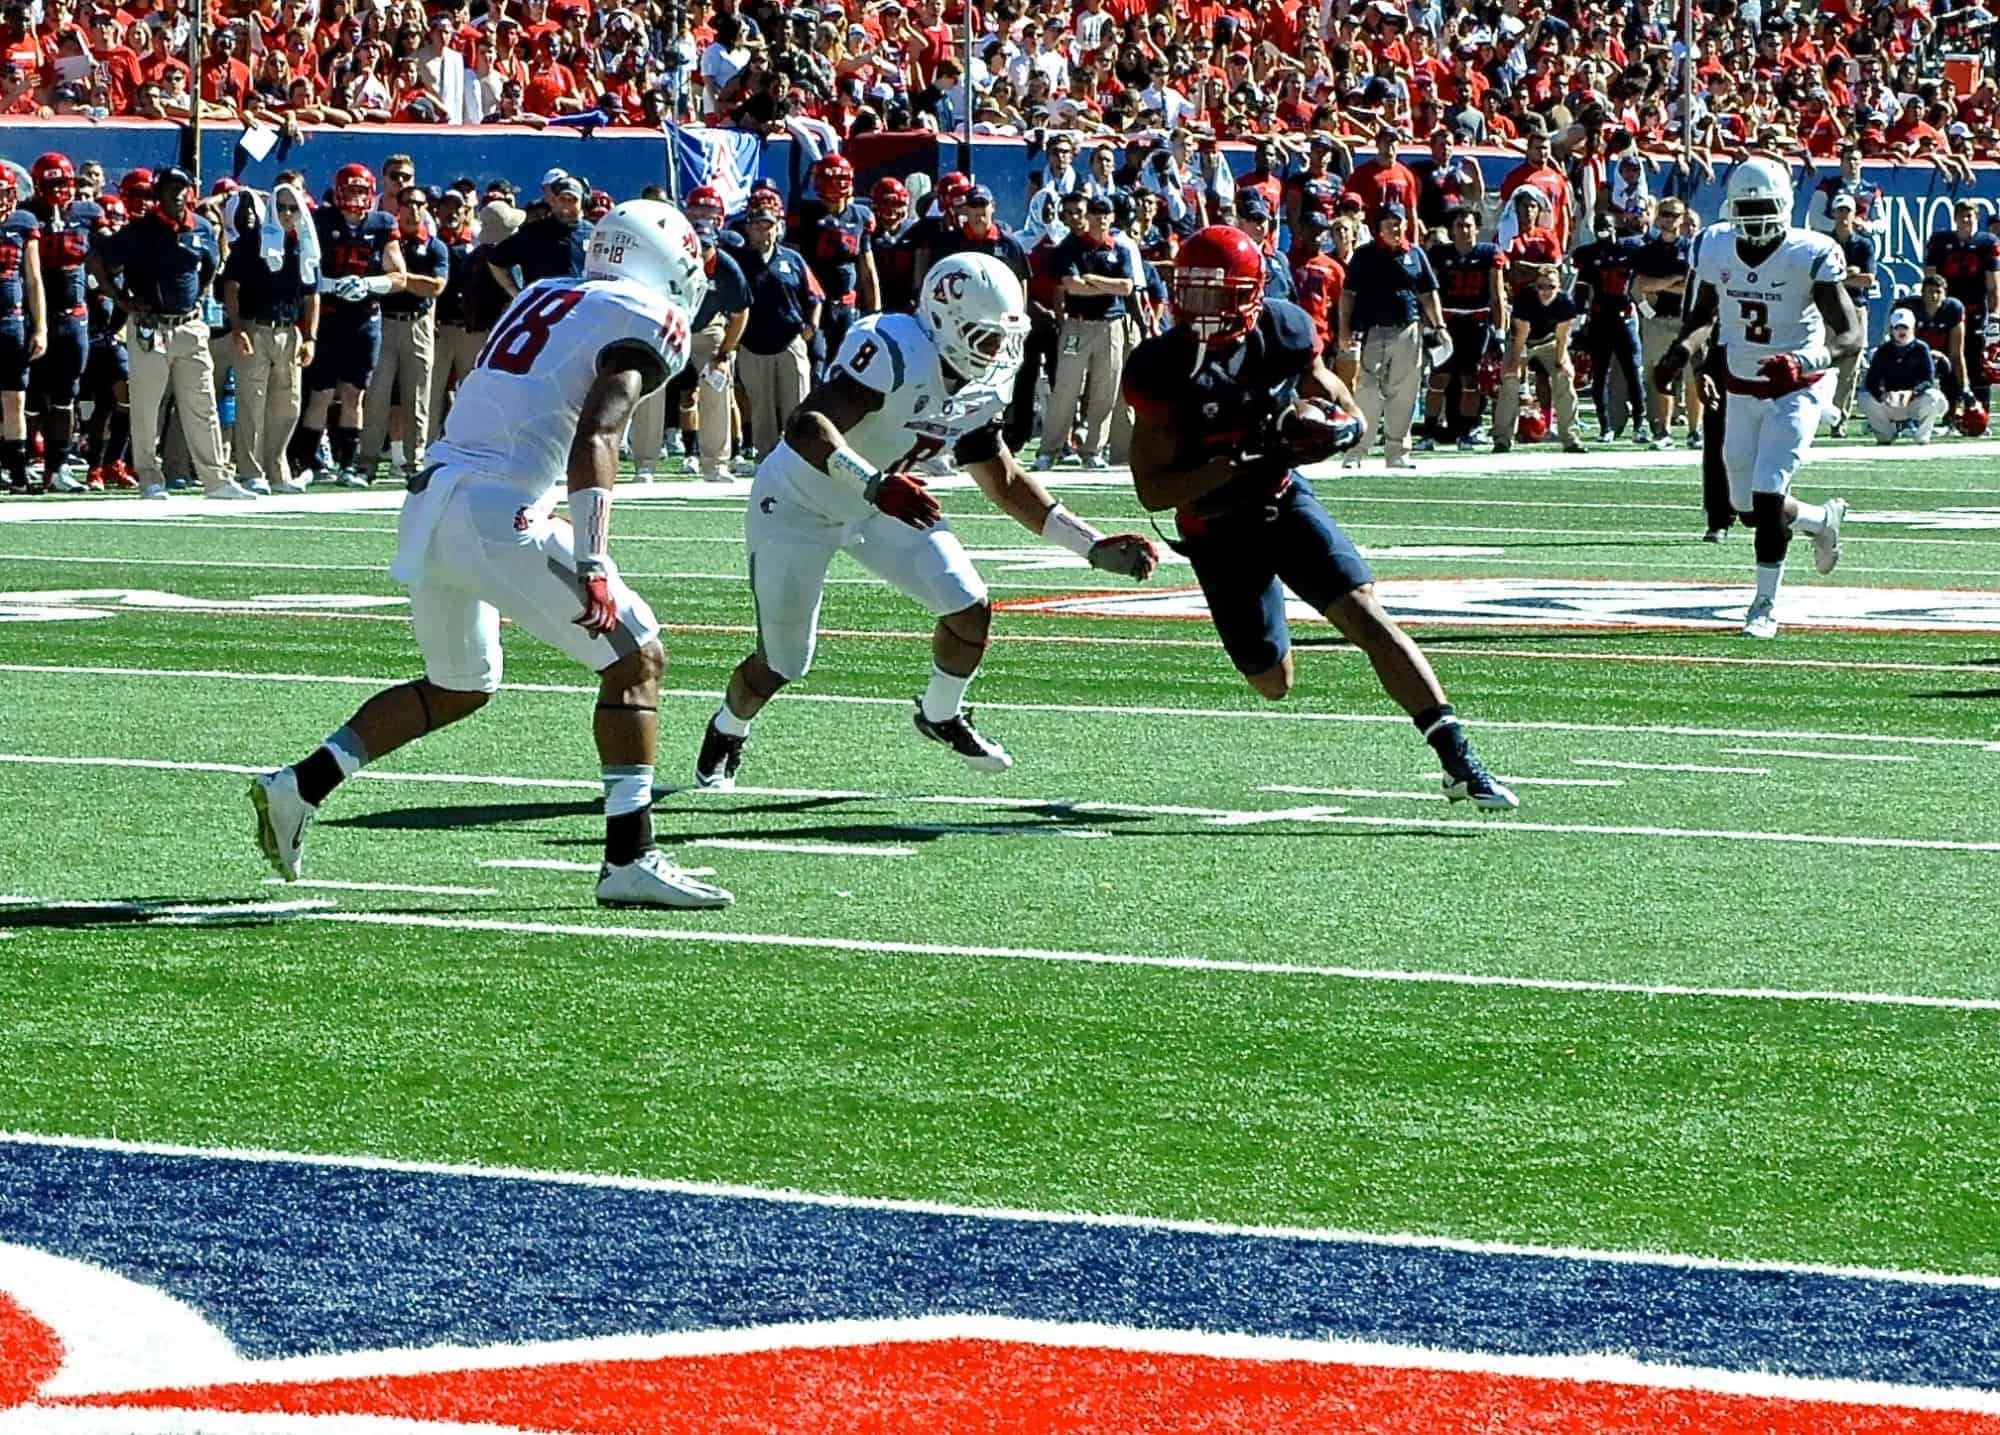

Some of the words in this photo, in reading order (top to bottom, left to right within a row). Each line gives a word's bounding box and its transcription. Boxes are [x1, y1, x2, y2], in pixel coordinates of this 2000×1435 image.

[608, 246, 624, 264] 18
[477, 287, 587, 375] 18
[849, 338, 879, 374] 8
